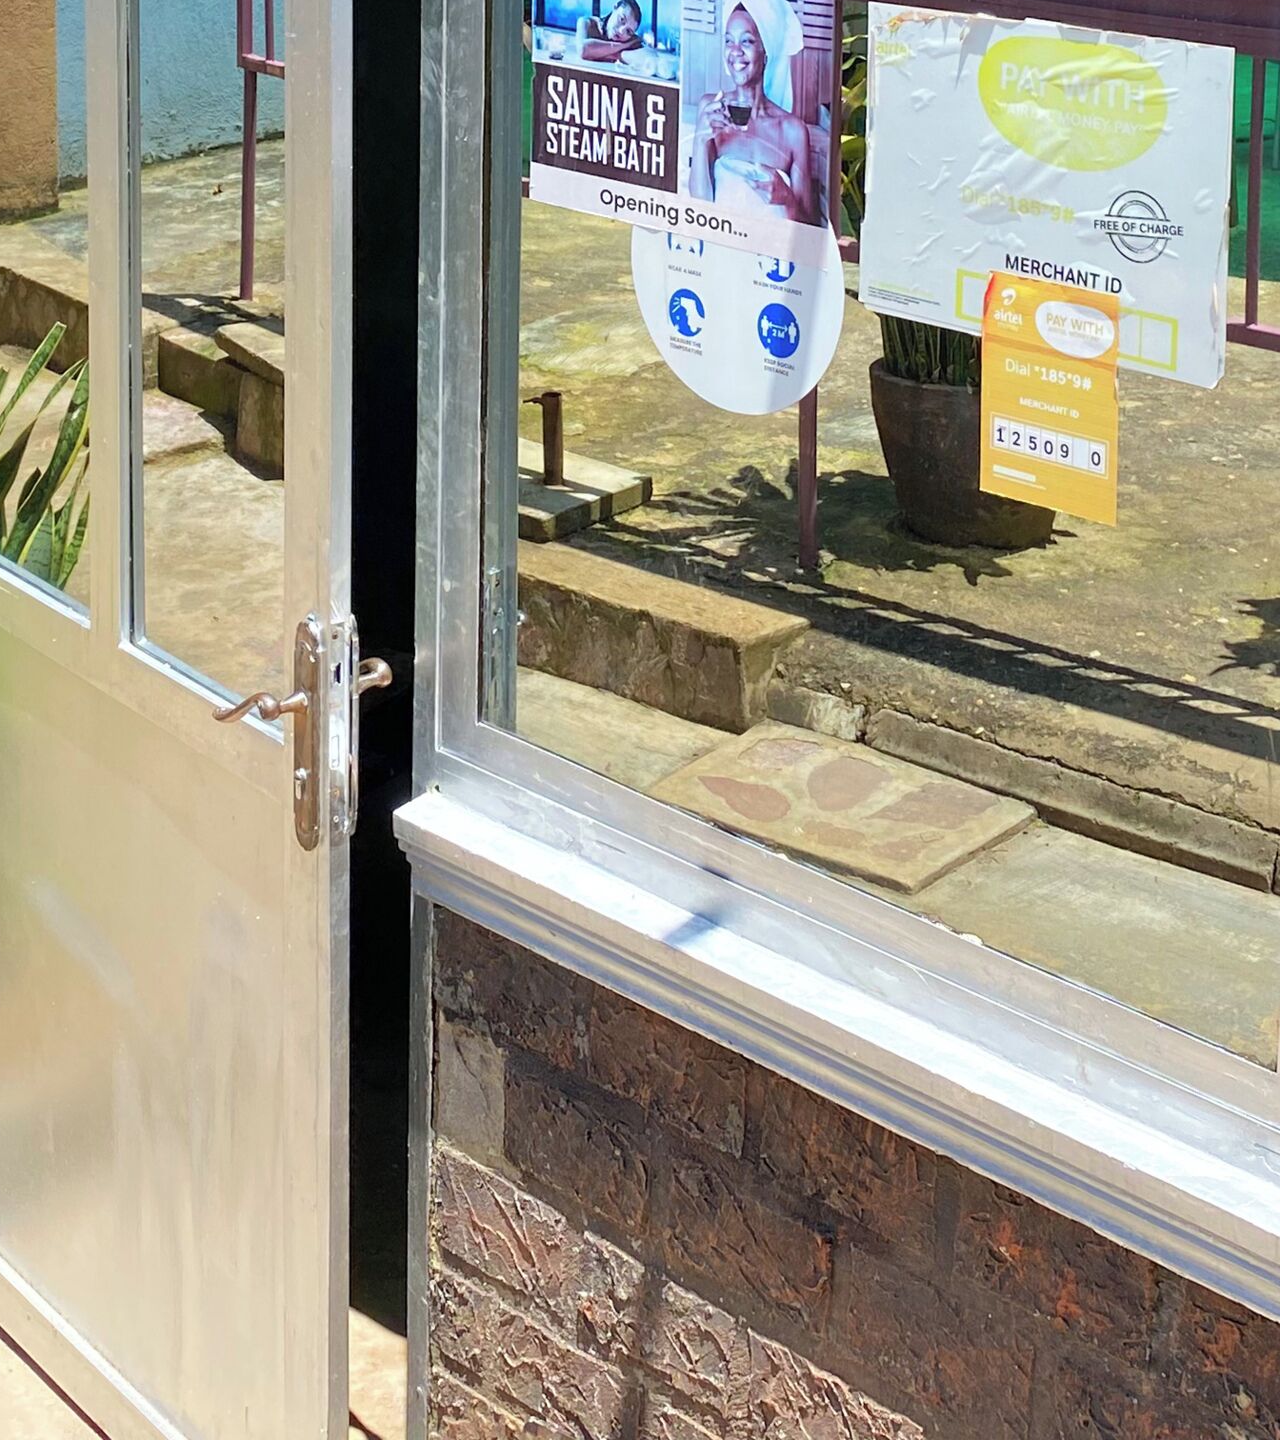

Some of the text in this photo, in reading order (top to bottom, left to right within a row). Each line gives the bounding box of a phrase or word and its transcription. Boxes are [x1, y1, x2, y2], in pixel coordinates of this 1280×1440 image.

[1000, 62, 1145, 113] PAY WITH
[547, 75, 666, 141] SAUNA &
[546, 122, 665, 177] STEAM BATH
[600, 189, 748, 238] Opening Soon...
[1094, 219, 1184, 237] FREE OF CHARGE
[1005, 253, 1122, 294] MERCHANT ID
[993, 308, 1023, 325] airtel
[1046, 312, 1068, 328] PAY
[1071, 317, 1105, 336] WITH
[1005, 358, 1031, 377] Dial
[1019, 397, 1080, 419] MERCHANT ID
